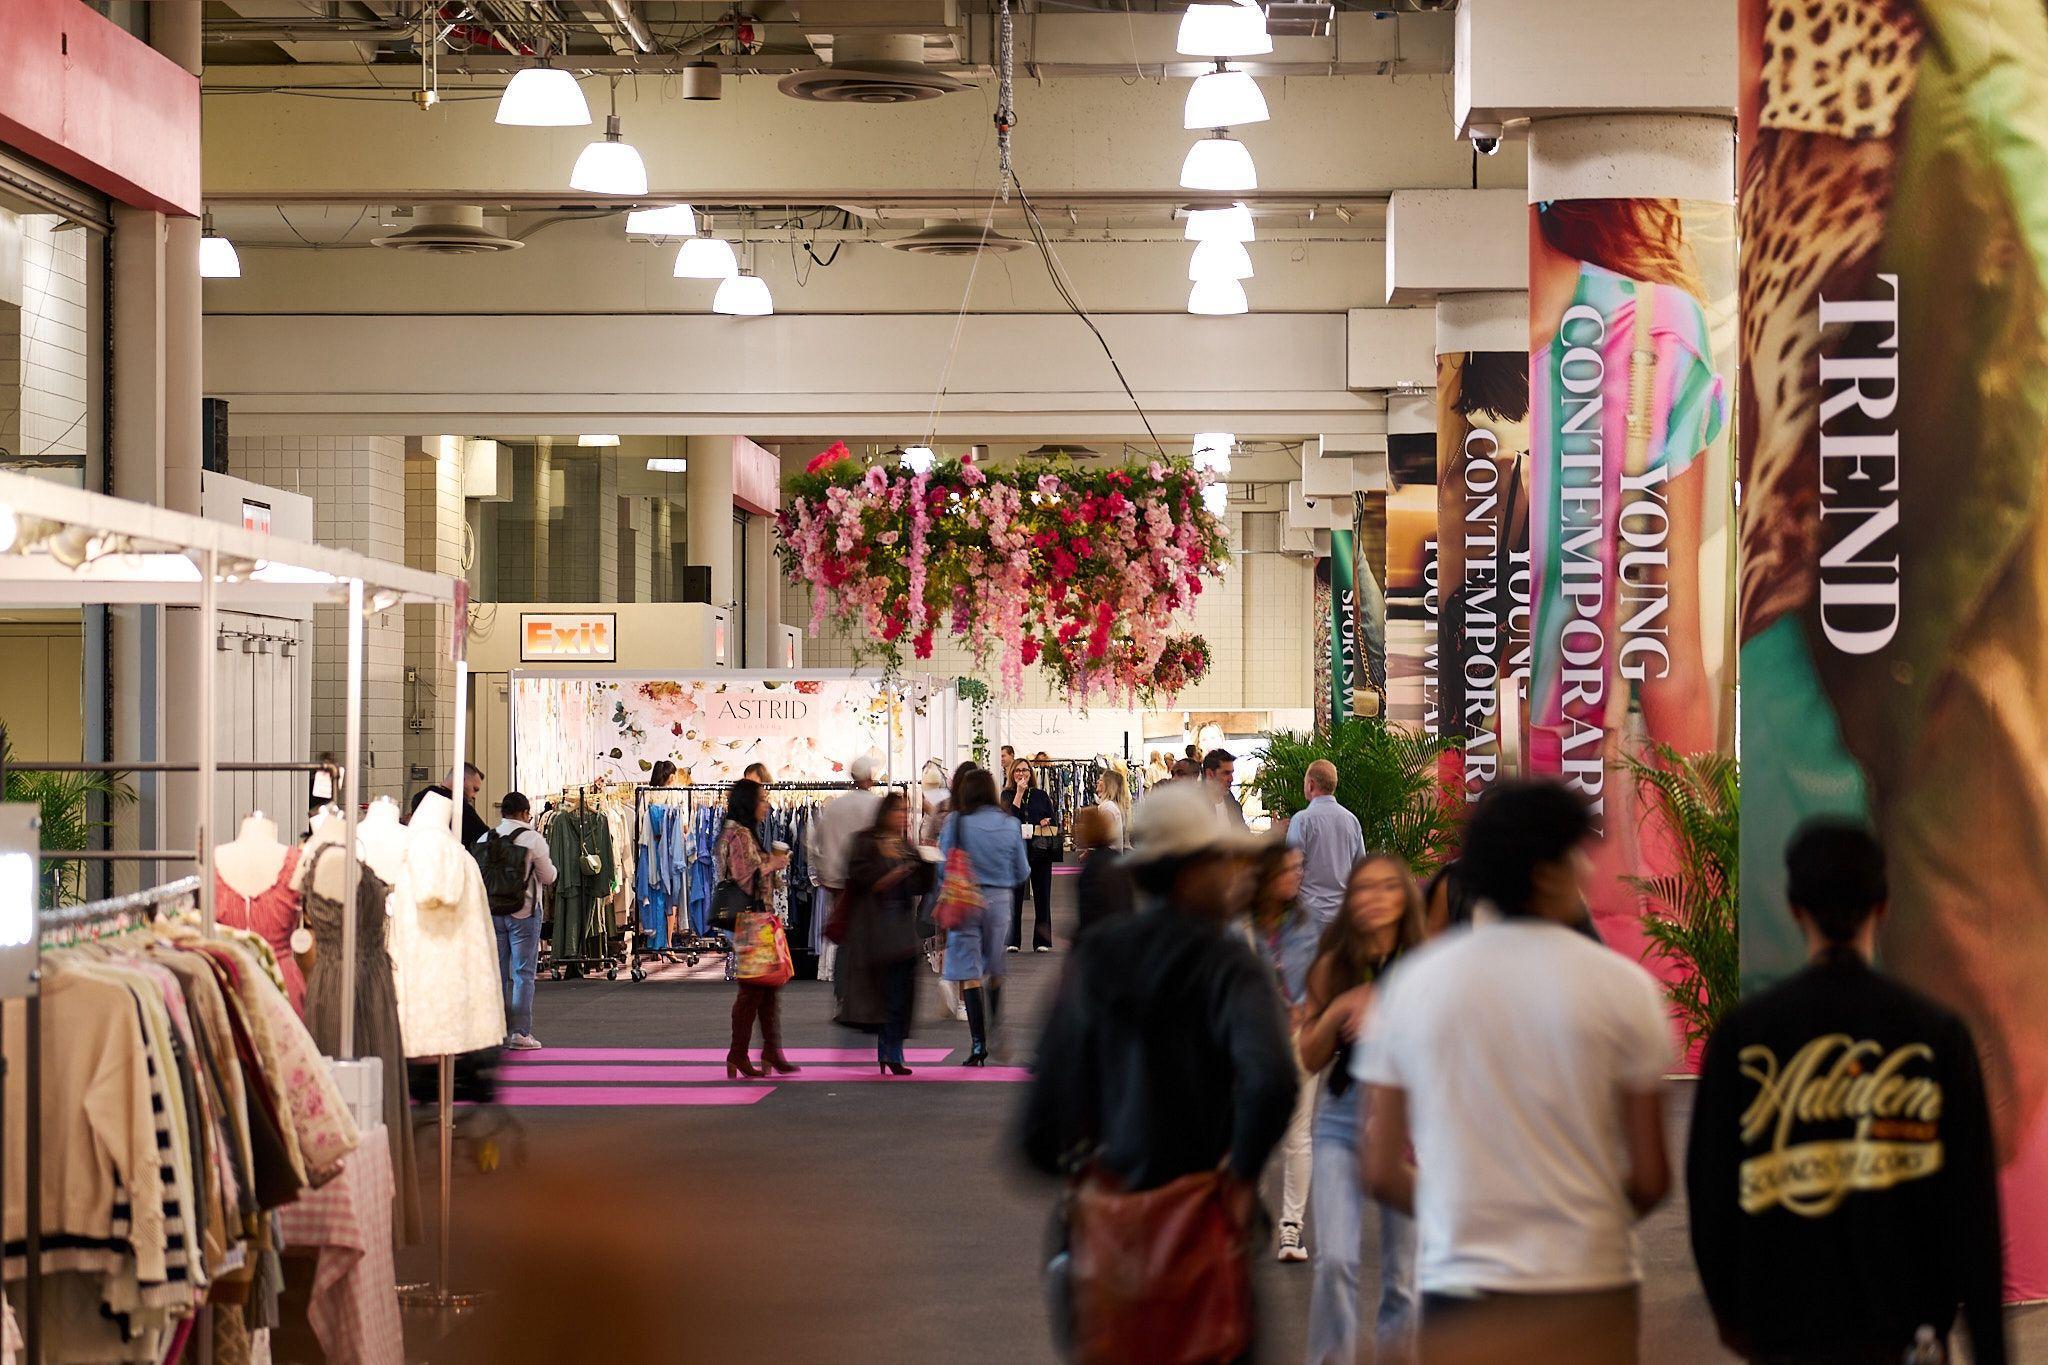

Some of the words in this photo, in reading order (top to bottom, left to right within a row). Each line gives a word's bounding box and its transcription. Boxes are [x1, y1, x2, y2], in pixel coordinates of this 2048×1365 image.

[1818, 273, 1900, 654] TREND
[1618, 463, 1669, 683] YOUNG
[527, 622, 610, 654] Exit
[718, 700, 807, 720] ASTRID
